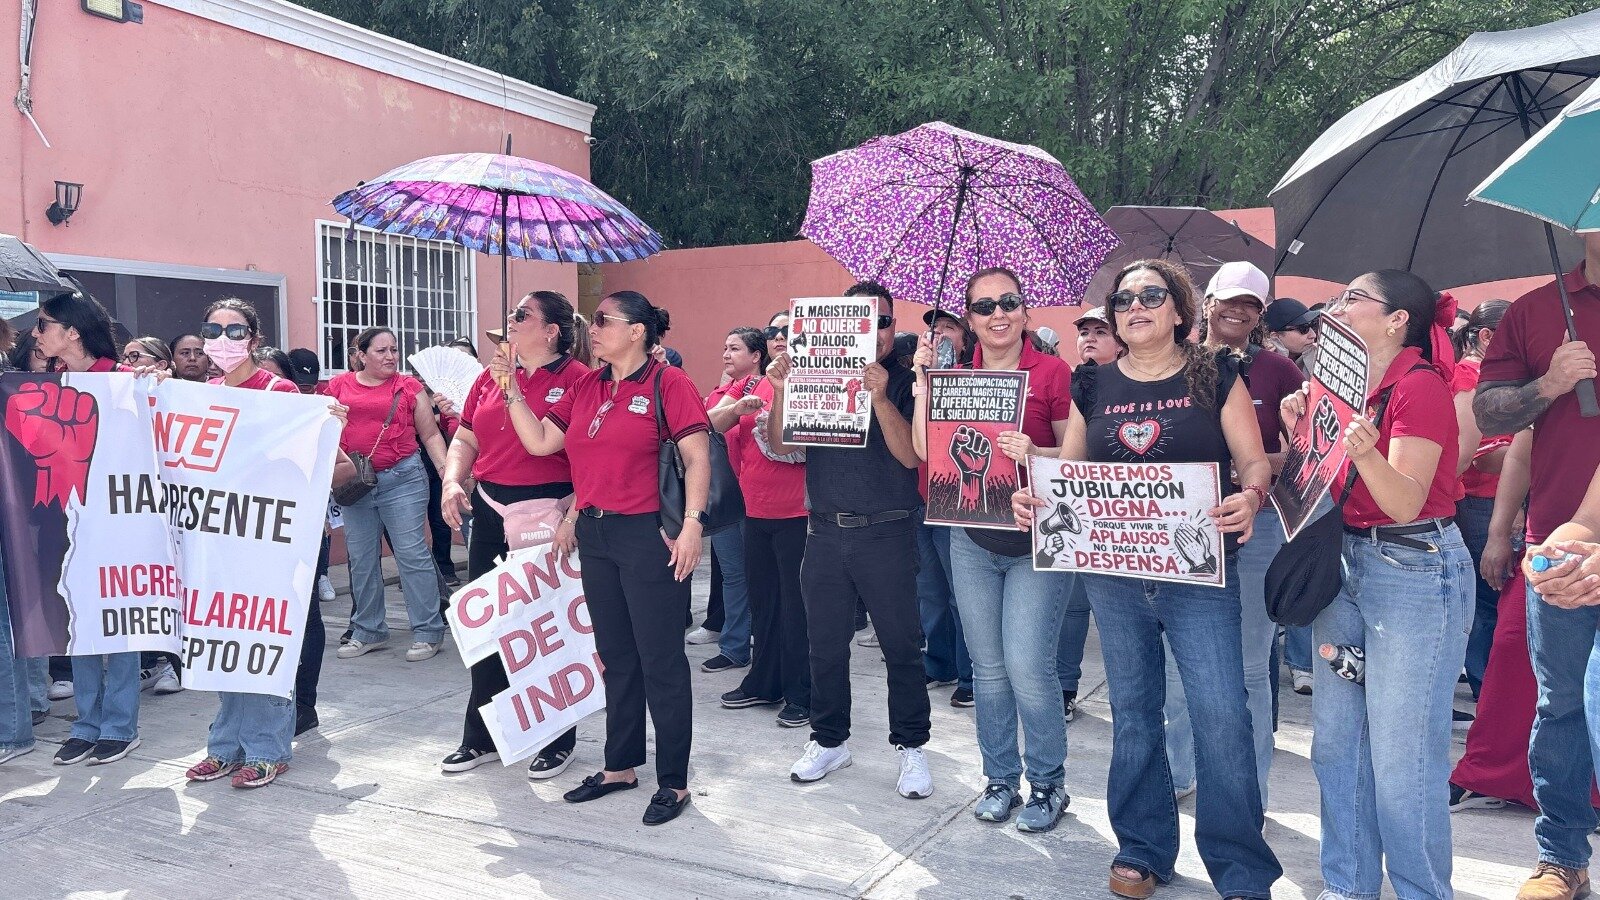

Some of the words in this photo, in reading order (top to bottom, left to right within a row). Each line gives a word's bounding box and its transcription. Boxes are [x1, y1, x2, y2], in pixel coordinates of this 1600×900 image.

[795, 306, 804, 317] EL
[808, 305, 870, 317] MAGISTERIO
[802, 319, 817, 333] NO
[820, 319, 861, 333] QUIERE
[792, 356, 866, 369] SOLUCIONES
[933, 378, 941, 386] NO
[943, 378, 947, 386] A
[949, 378, 956, 386] LA
[958, 377, 1019, 388] DESCOMPACTACIÓN
[933, 388, 941, 396] DE
[943, 388, 970, 396] CARRERA
[972, 388, 1017, 398] MAGISTERIAL
[1338, 381, 1354, 405] BASE
[1353, 392, 1363, 410] 07
[790, 401, 818, 409] ISSSTE
[821, 402, 843, 410] 2007!
[932, 397, 939, 408] Y
[941, 397, 1016, 410] DIFERENCIALES
[1105, 403, 1135, 414] LOVE
[1140, 402, 1152, 412] IS
[1158, 397, 1191, 410] LOVE
[932, 409, 945, 420] DEL
[947, 409, 976, 420] SUELDO
[979, 410, 999, 421] BASE
[1002, 411, 1014, 421] 07
[152, 411, 225, 458] NTE
[1060, 463, 1173, 481] QUEREMOS
[1050, 479, 1185, 499] JUBILACIÓN
[1087, 500, 1187, 517] DIGNA...
[1093, 521, 1126, 530] PORQUE
[1089, 529, 1170, 545] APLAUSOS
[1094, 543, 1106, 551] NO
[1112, 545, 1139, 554] PAGA
[1143, 546, 1156, 554] LA
[1075, 551, 1186, 574] DESPENSA.
[499, 611, 565, 674] DE
[247, 643, 284, 676] 07
